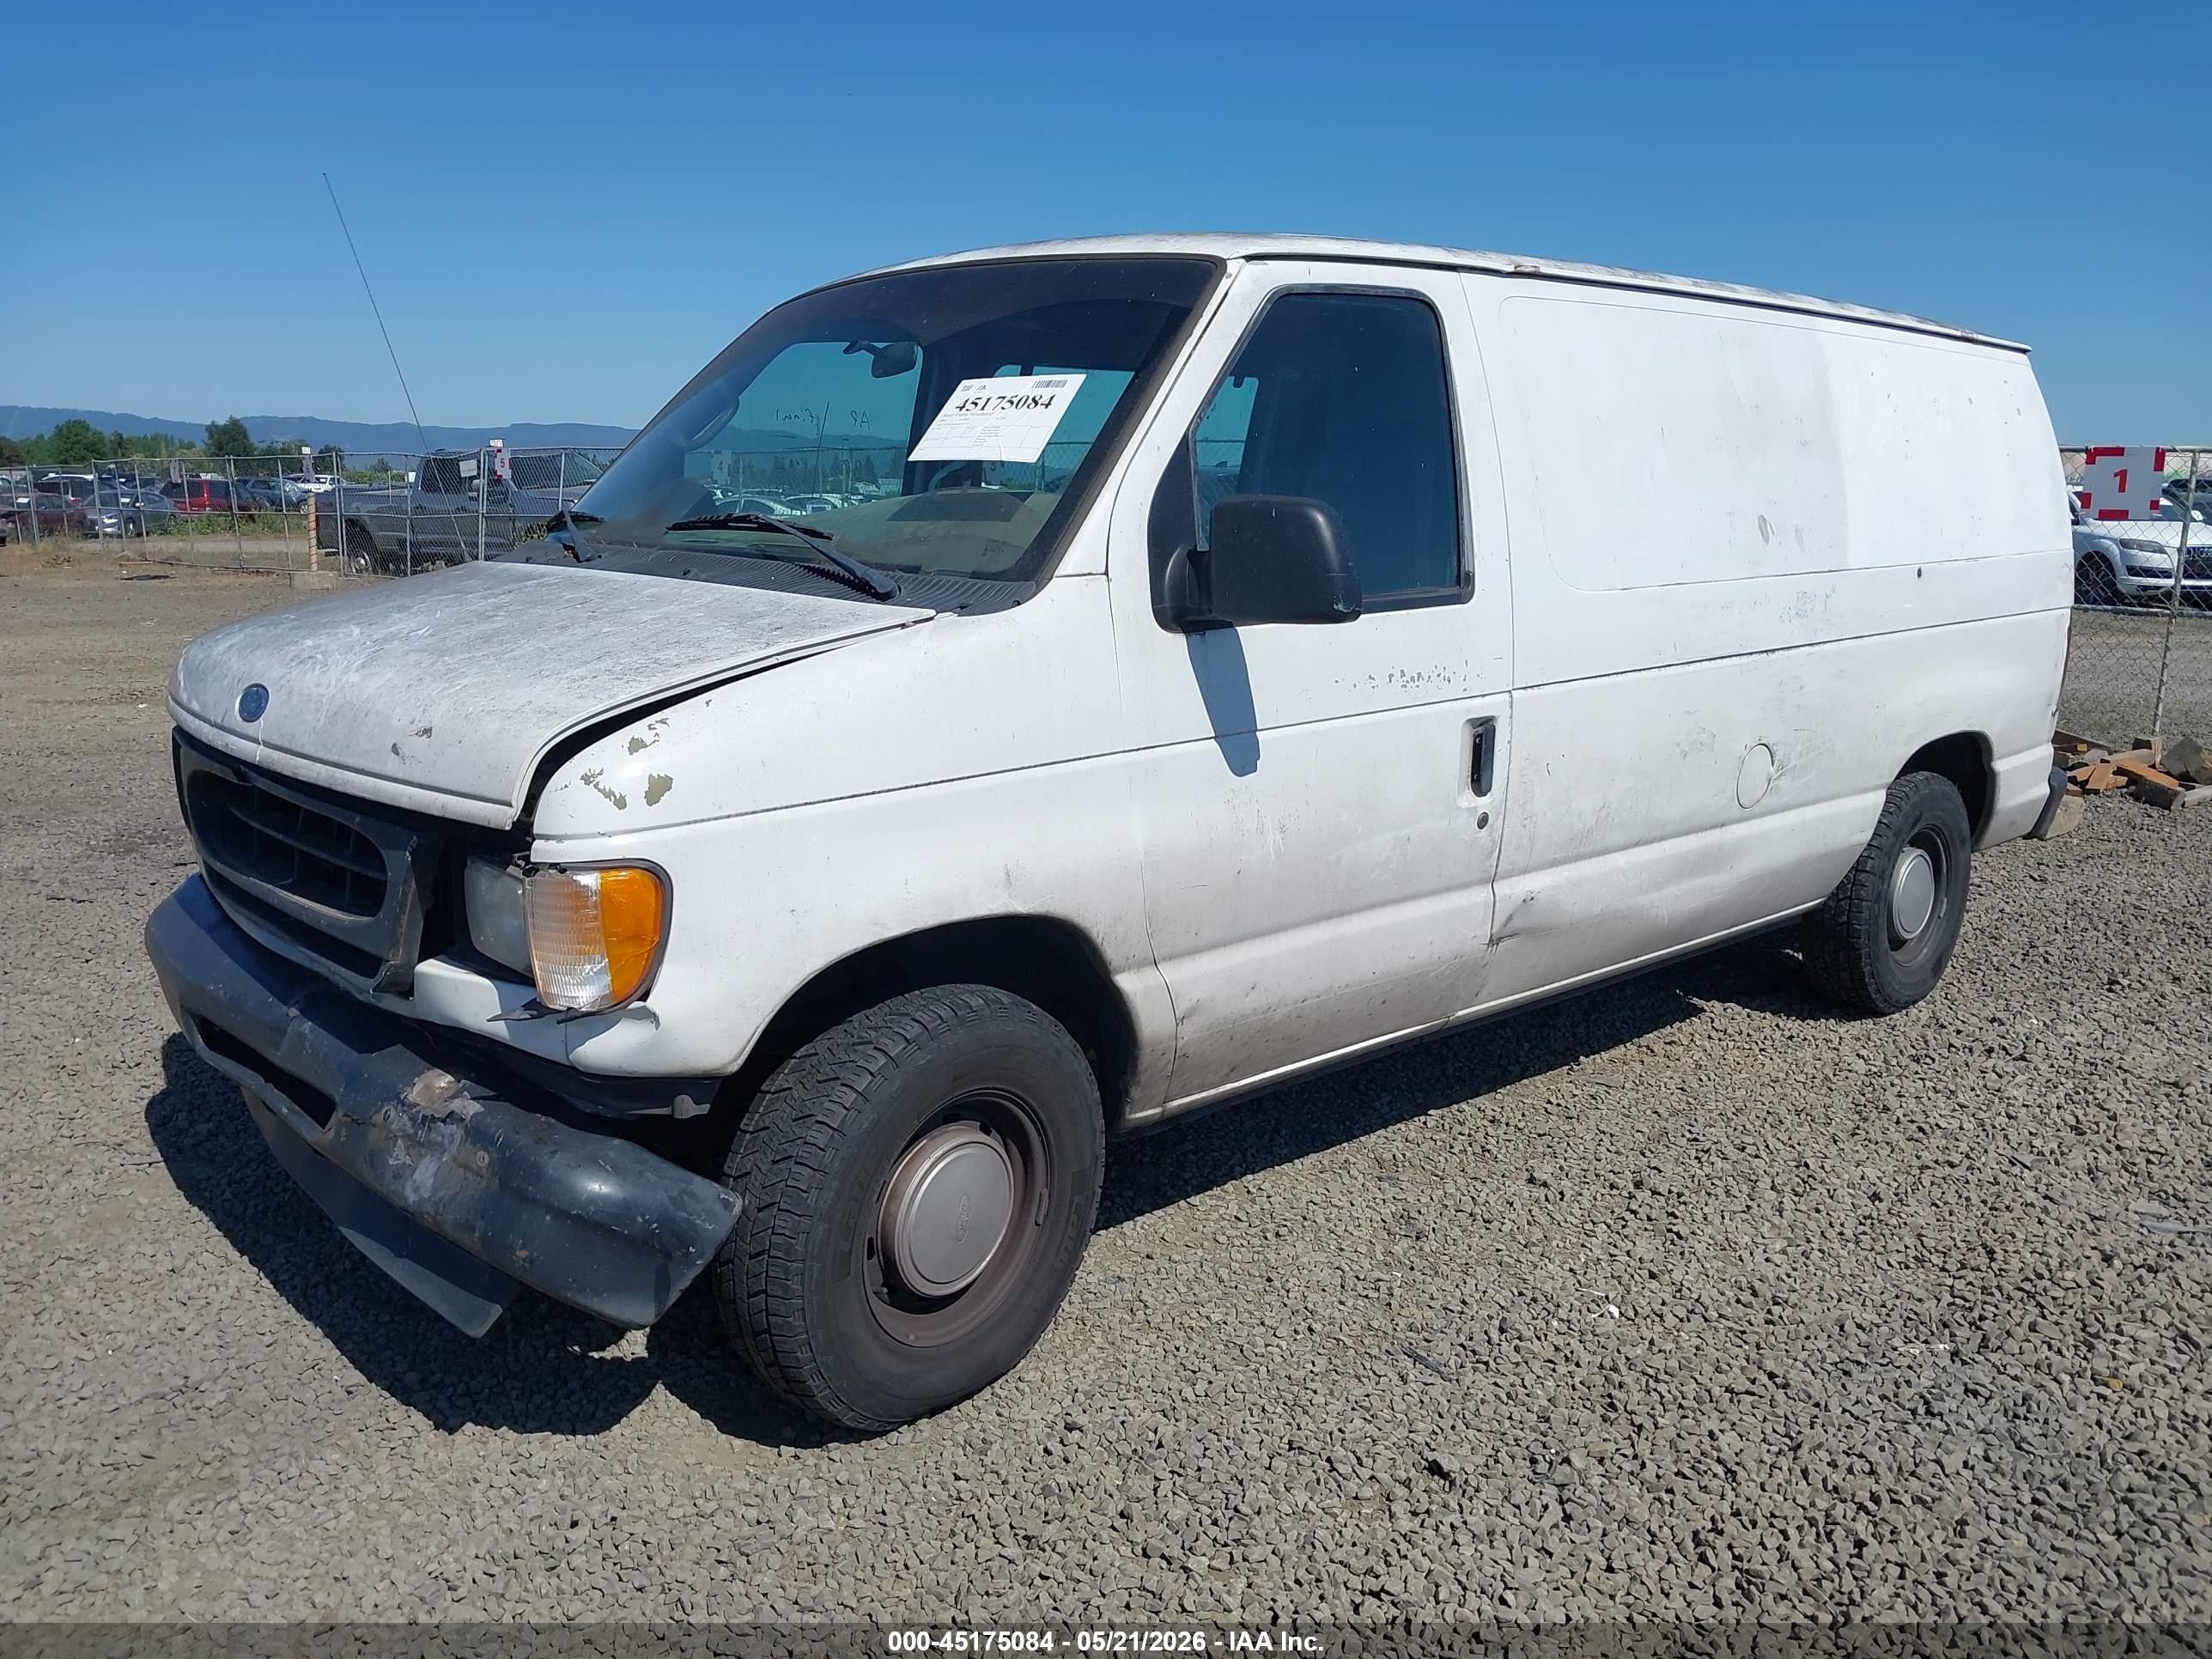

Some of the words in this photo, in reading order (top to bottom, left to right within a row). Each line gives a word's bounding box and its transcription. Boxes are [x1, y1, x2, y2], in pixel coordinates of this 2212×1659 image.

[955, 393, 1056, 411] 45175084
[500, 458, 506, 468] 5
[2113, 469, 2128, 493] 1
